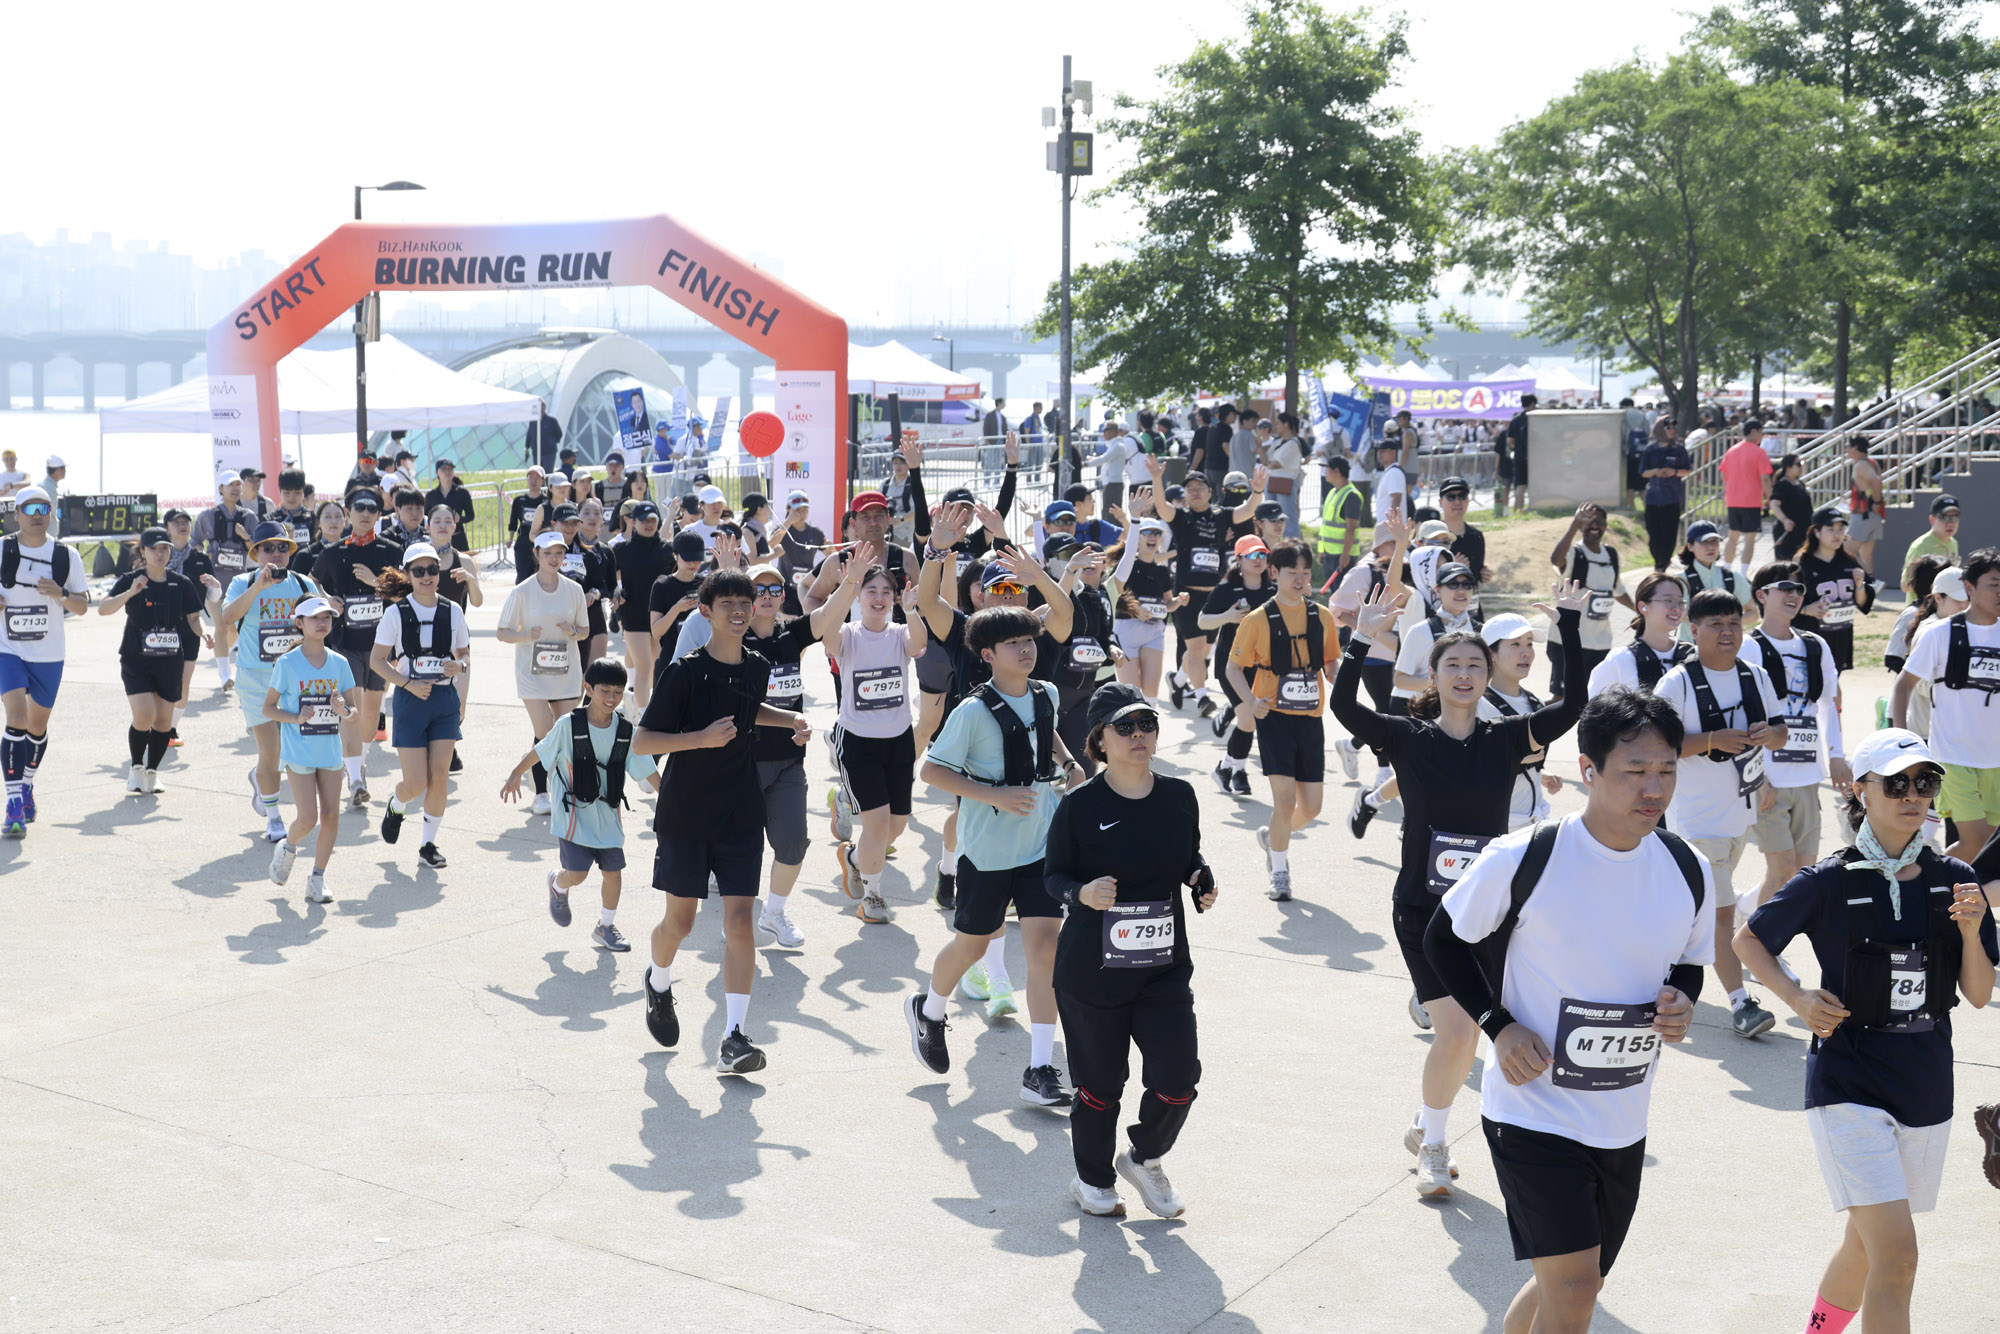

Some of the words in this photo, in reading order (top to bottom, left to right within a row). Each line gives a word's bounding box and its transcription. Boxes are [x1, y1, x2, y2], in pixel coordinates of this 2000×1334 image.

[375, 255, 526, 285] BURNING
[538, 251, 612, 281] RUN
[658, 248, 780, 336] FINISH
[235, 257, 326, 340] START
[623, 430, 652, 448] 정근식
[786, 471, 810, 479] KIND
[97, 496, 141, 506] SAMIK
[360, 605, 381, 614] 7127
[22, 618, 47, 626] 7133
[158, 635, 178, 643] 7550
[778, 678, 802, 690] 7523
[874, 680, 901, 692] 7975
[1794, 733, 1818, 743] 7087
[1444, 857, 1456, 868] W
[1118, 929, 1130, 938] W
[1135, 922, 1172, 938] 7913
[1565, 1005, 1604, 1017] BURNING
[1605, 1010, 1625, 1018] RUN
[1577, 1038, 1594, 1051] M
[1601, 1035, 1656, 1053] 7155
